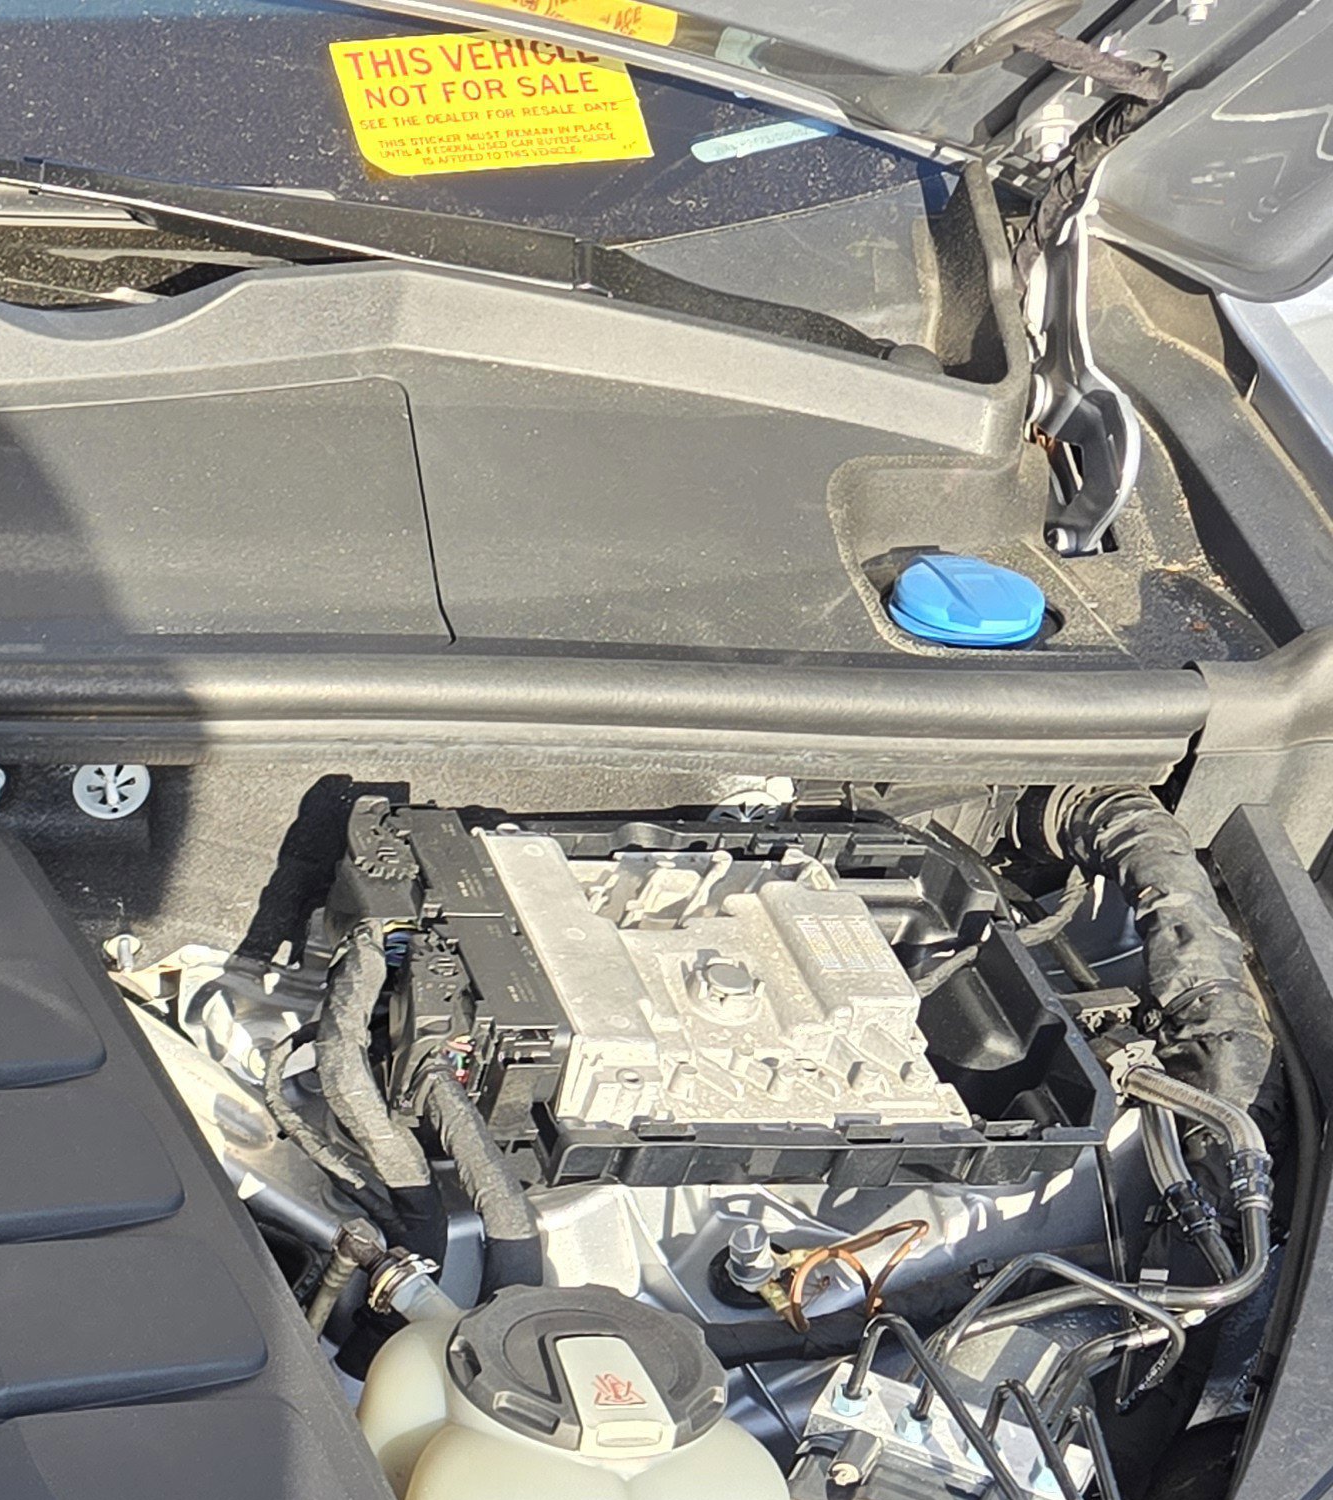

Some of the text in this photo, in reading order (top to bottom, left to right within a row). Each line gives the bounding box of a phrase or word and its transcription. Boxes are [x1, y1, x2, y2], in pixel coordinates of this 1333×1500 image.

[344, 49, 433, 81] THIS
[365, 71, 599, 110] NOT FOR SALE
[359, 101, 619, 130] SEE THE DEALER FOR RESALE DATE
[378, 138, 406, 149] THIS
[466, 130, 500, 142] MUST
